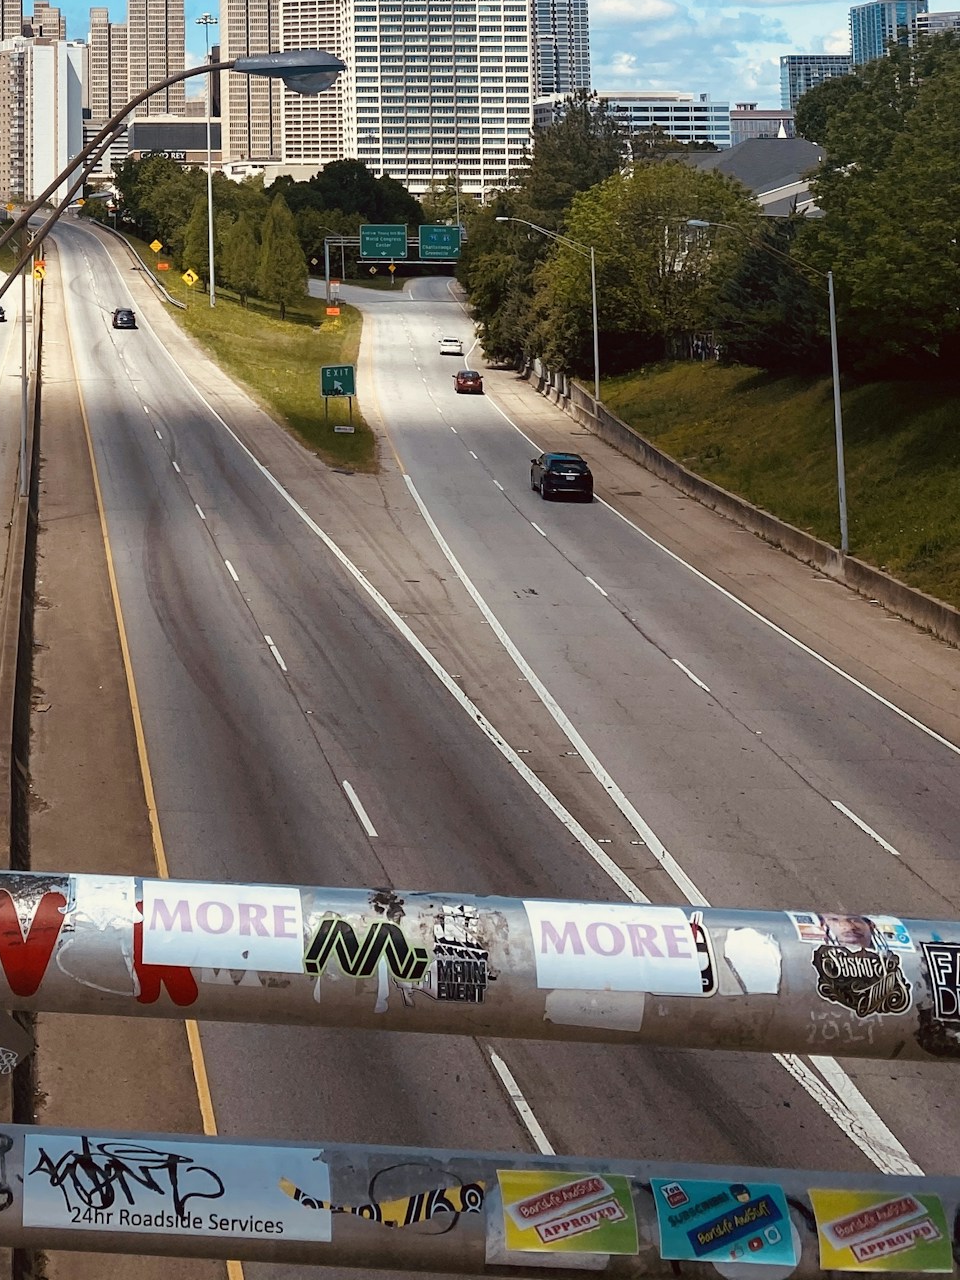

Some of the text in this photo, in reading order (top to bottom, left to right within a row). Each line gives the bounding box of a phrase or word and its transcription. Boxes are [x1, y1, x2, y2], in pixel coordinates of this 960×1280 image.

[326, 368, 349, 377] EXIT
[148, 898, 298, 939] MORE
[540, 920, 693, 959] MORE
[437, 960, 487, 982] MAIN
[437, 983, 487, 1003] EVENT
[662, 1186, 680, 1195] You
[71, 1206, 284, 1234] 24hr Roadside Services
[544, 1206, 617, 1238] APPROVED
[860, 1226, 933, 1257] APPROVED
